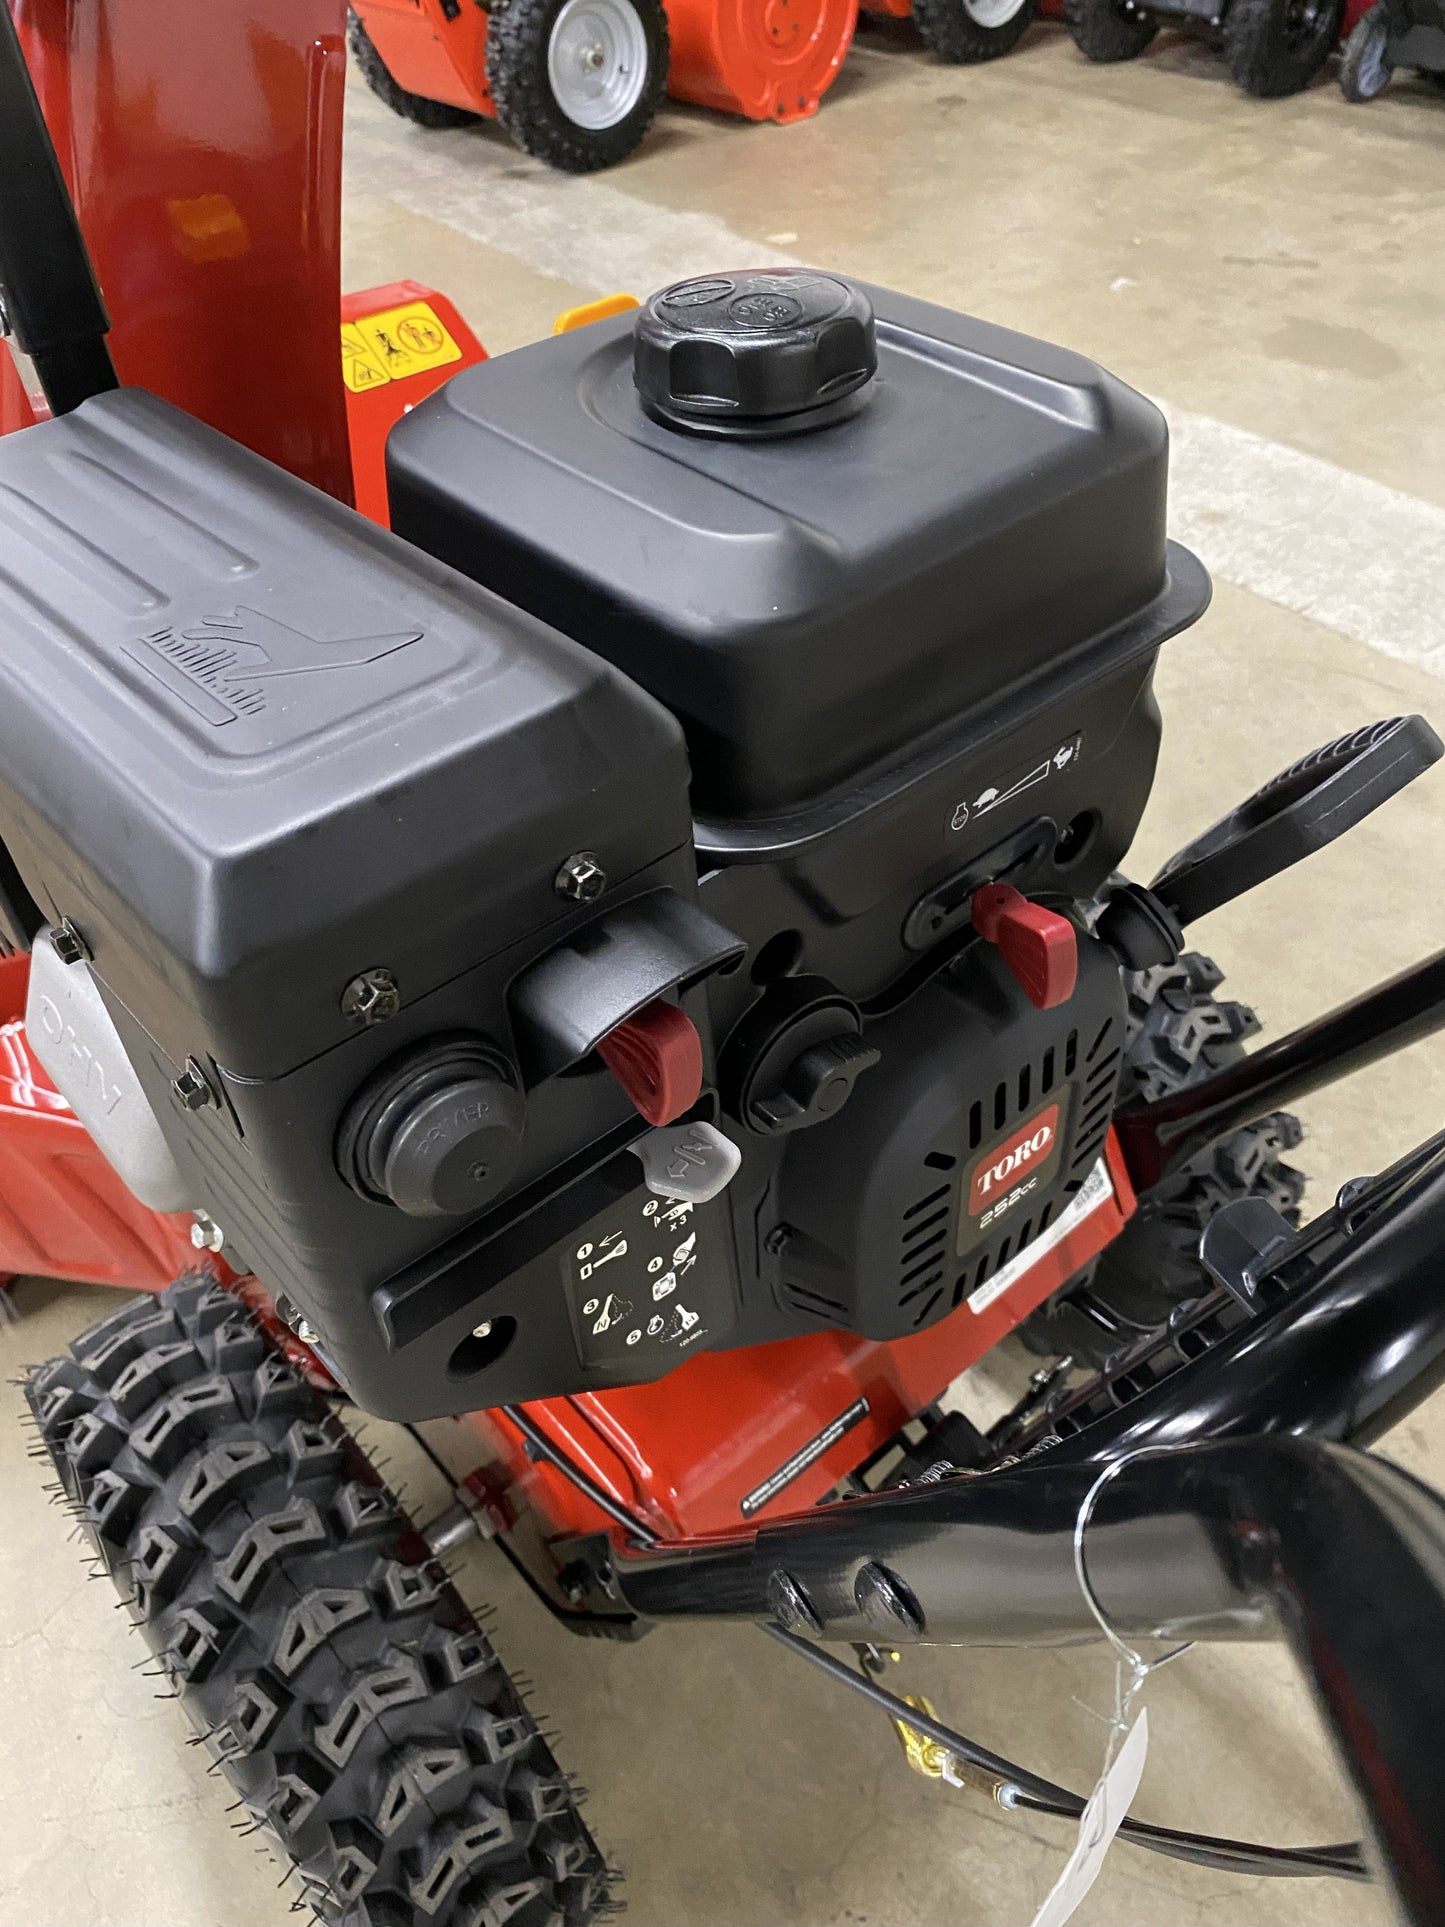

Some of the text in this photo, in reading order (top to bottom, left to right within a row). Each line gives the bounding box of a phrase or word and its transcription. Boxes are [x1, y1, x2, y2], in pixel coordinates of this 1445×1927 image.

[415, 1101, 490, 1155] PRMER
[977, 1126, 1051, 1196] TORO
[679, 1214, 688, 1225] 3
[979, 1176, 1038, 1230] 252cc
